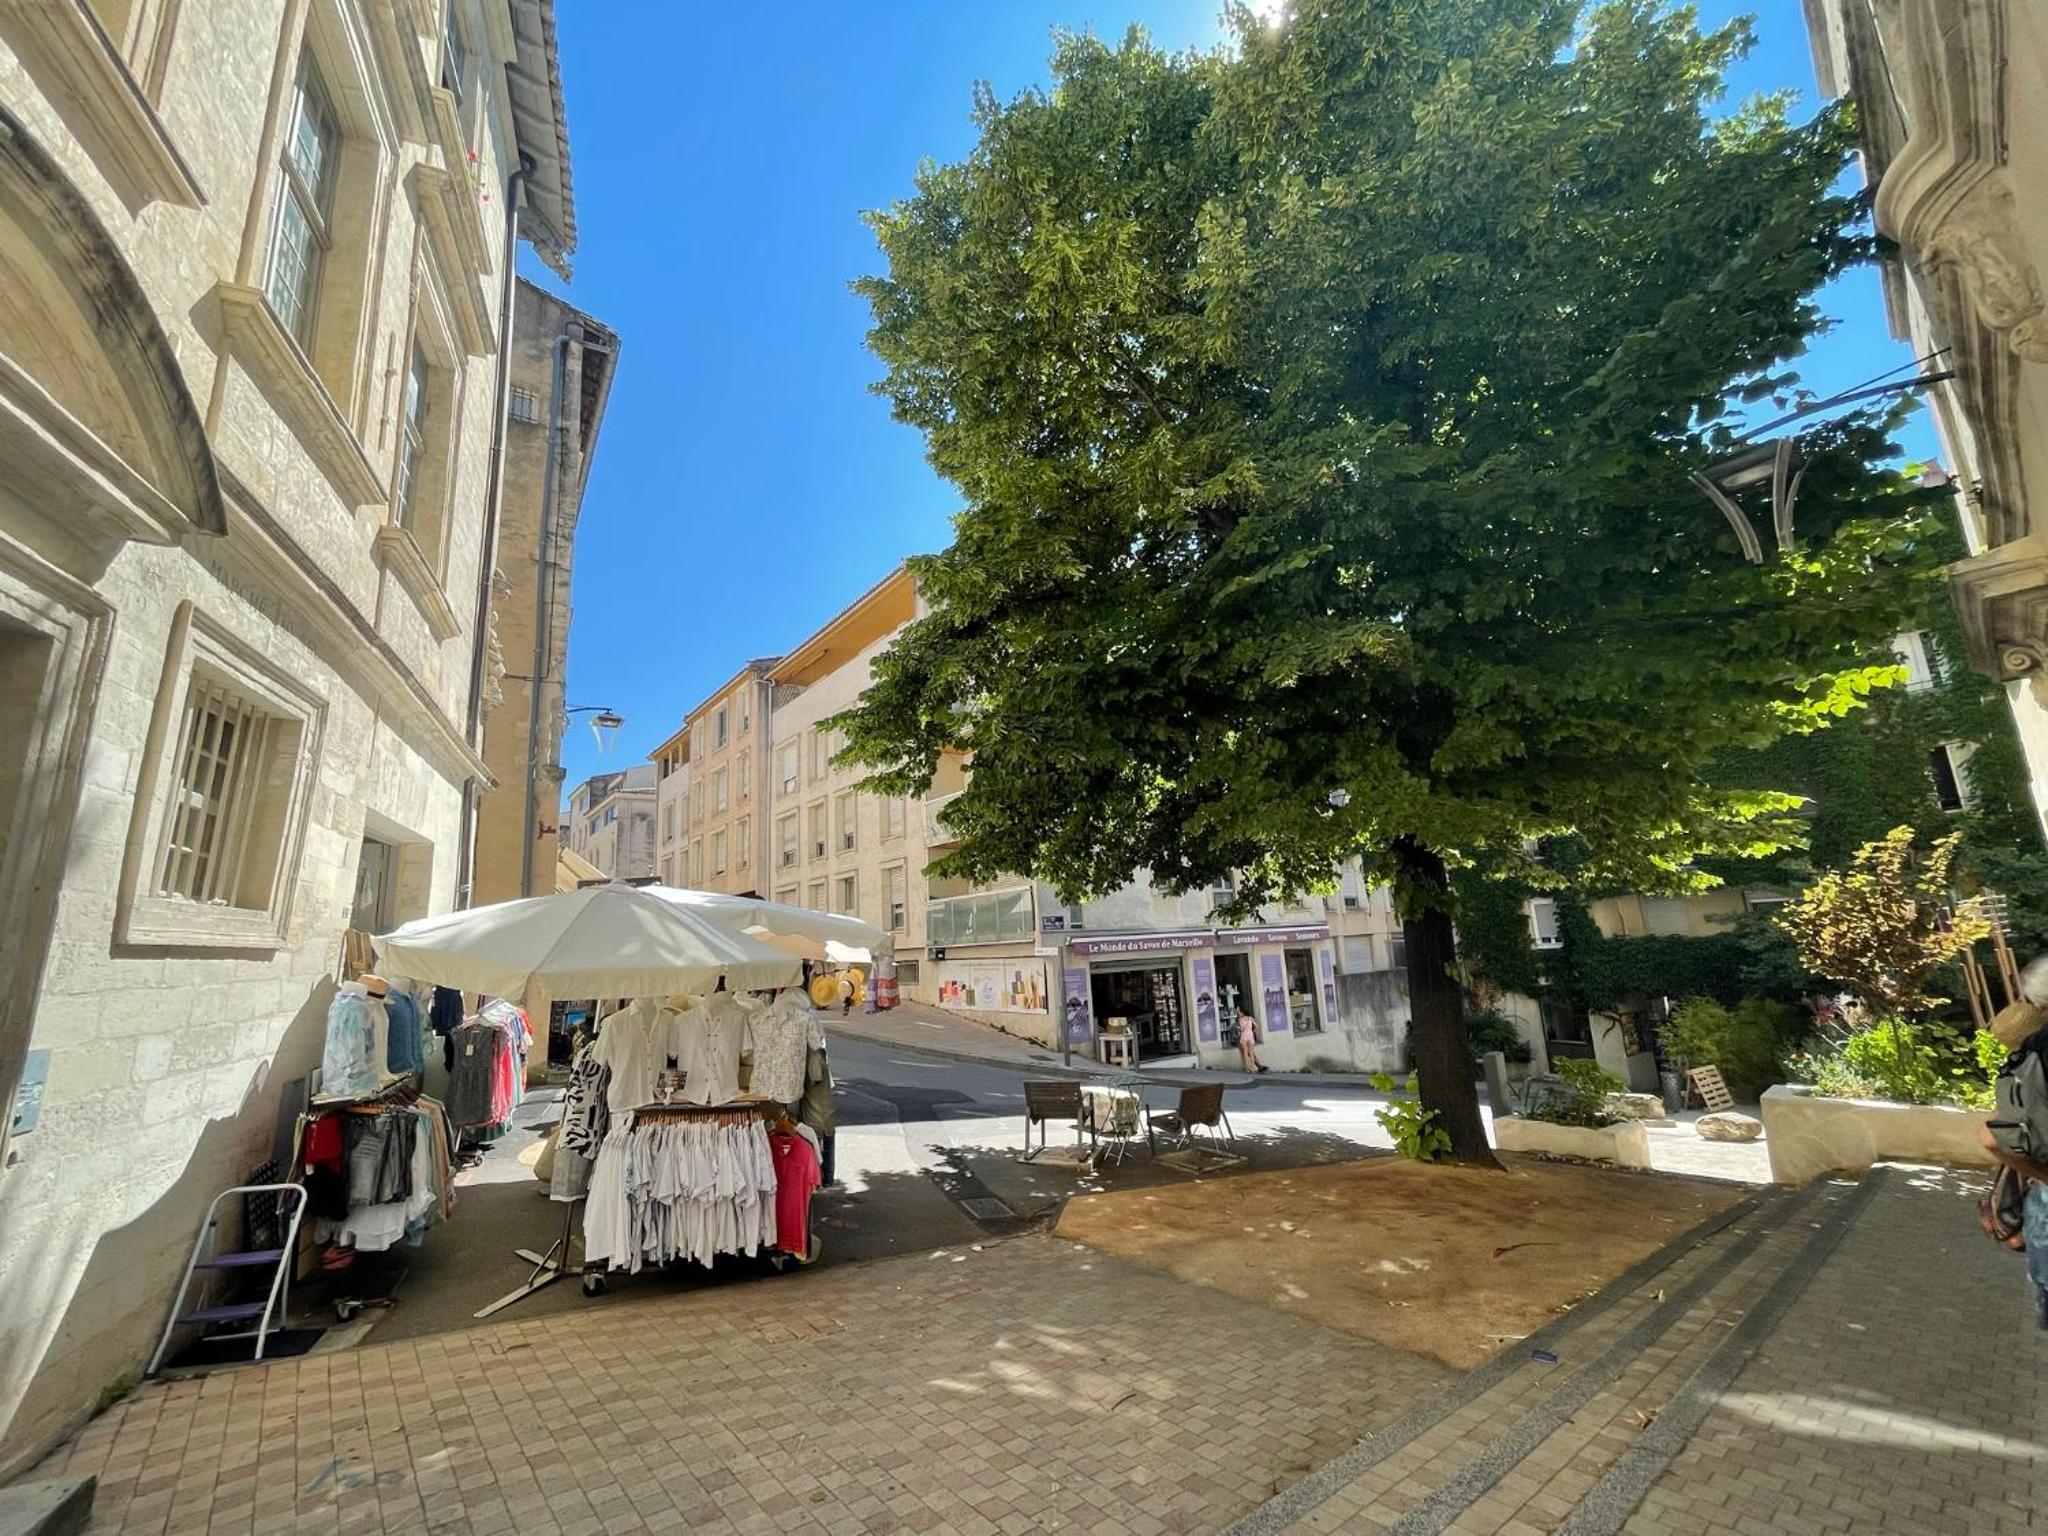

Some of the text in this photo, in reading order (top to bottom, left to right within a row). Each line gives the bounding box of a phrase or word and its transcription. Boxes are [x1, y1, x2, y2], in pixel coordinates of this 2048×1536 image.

[1089, 938, 1203, 952] Le Monde du Savon de Marseille
[1233, 936, 1259, 945] Lavande
